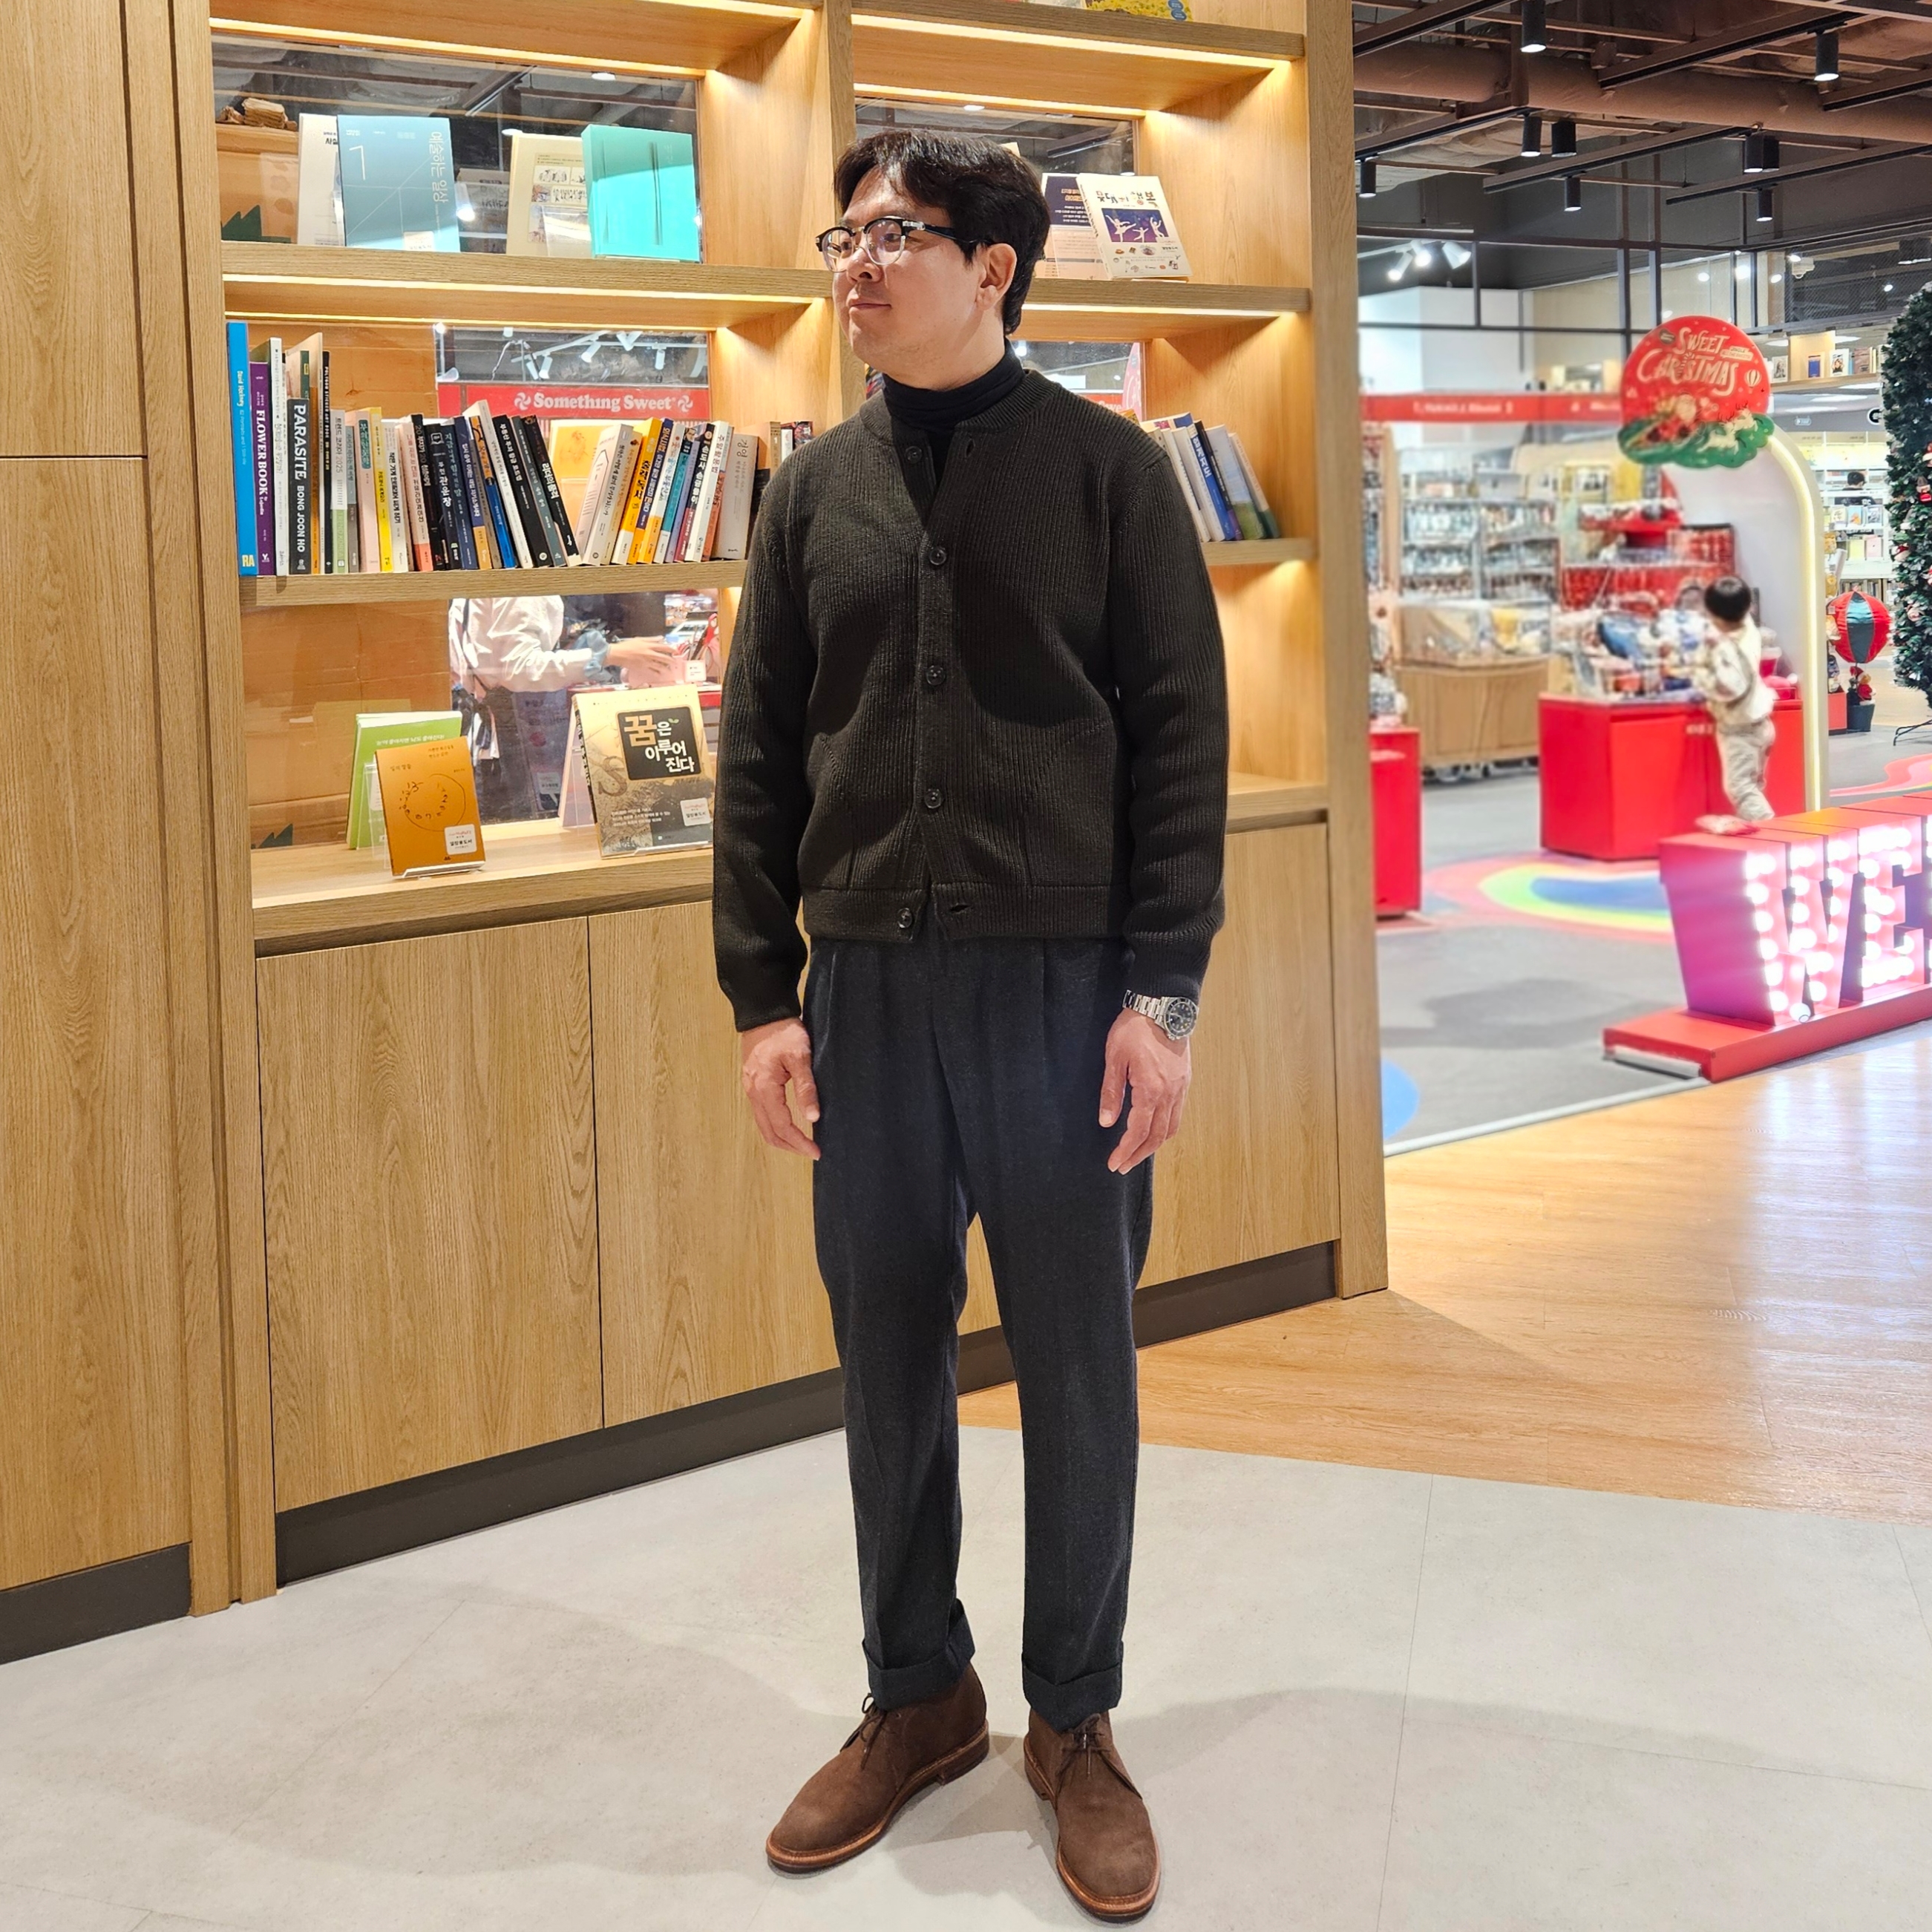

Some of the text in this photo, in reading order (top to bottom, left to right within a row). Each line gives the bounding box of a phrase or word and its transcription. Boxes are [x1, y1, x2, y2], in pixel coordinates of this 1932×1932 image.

[428, 131, 448, 203] 예술하는 일상
[1674, 327, 1729, 353] SWEET
[235, 385, 245, 407] Hockney
[534, 392, 672, 412] Something Sweet
[293, 404, 306, 479] PARASITE
[499, 422, 510, 441] 부동산
[255, 409, 267, 494] FLOWER BOOK
[414, 425, 422, 435] 20
[419, 453, 426, 463] 20
[504, 439, 514, 452] 투자
[736, 438, 749, 457] 경영
[389, 464, 396, 476] 가게
[540, 462, 554, 485] 리더의
[296, 485, 304, 510] BONG
[297, 539, 304, 552] HO
[242, 554, 254, 567] RA
[623, 714, 672, 747] 꿈은
[644, 739, 686, 761] 이루어
[666, 756, 695, 773] 진다
[1745, 815, 1932, 1026] WE
